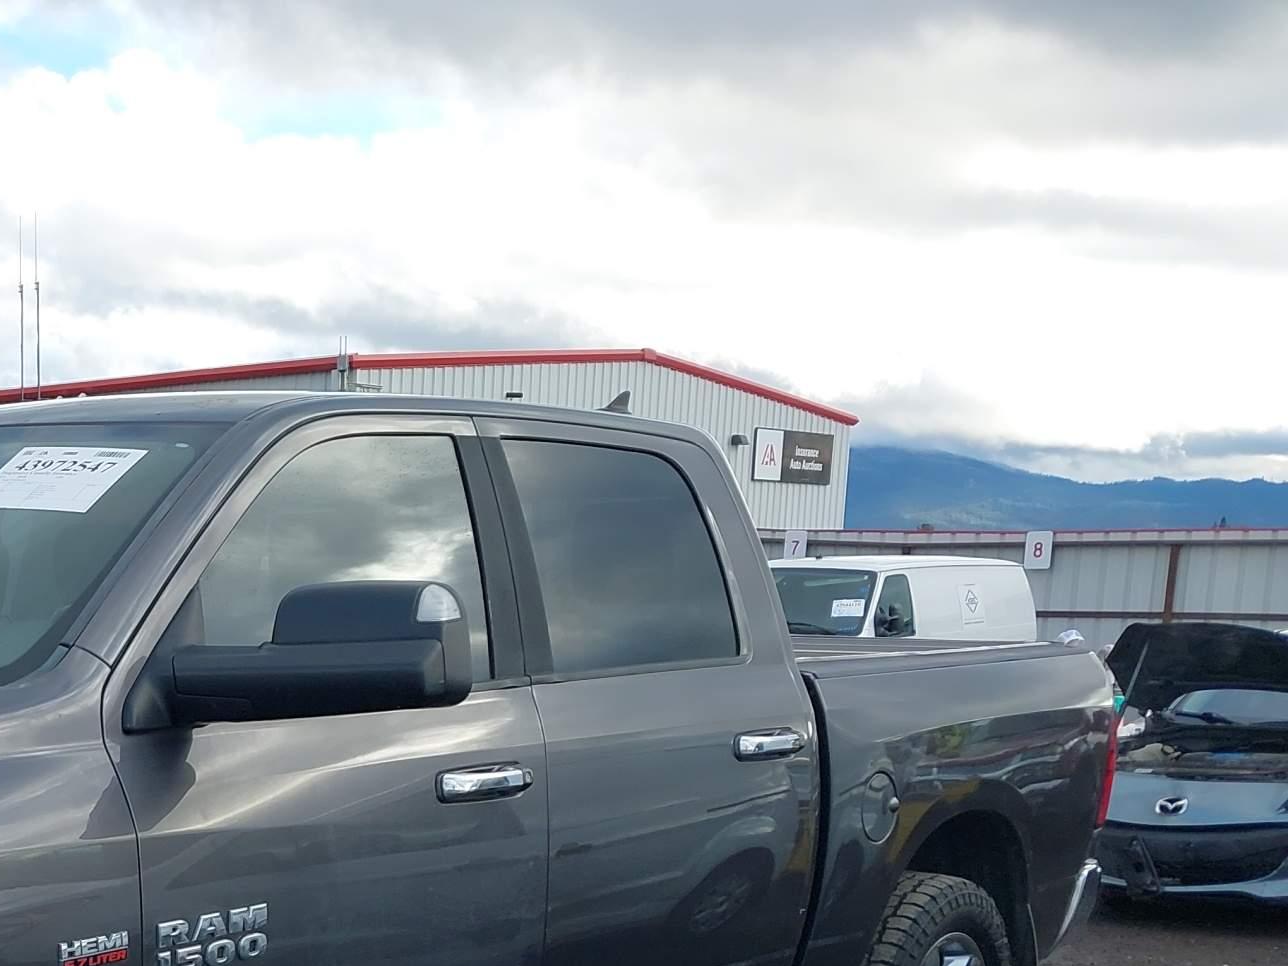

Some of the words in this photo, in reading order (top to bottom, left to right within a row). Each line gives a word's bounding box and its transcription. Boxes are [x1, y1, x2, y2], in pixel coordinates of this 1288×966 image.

[795, 445, 820, 458] Insurance
[15, 459, 119, 473] 43972547
[790, 458, 802, 470] Auto
[802, 459, 824, 471] Auctions
[790, 540, 801, 555] 7
[1033, 542, 1044, 558] 8
[156, 902, 269, 948] RAM
[58, 930, 130, 960] HEMI
